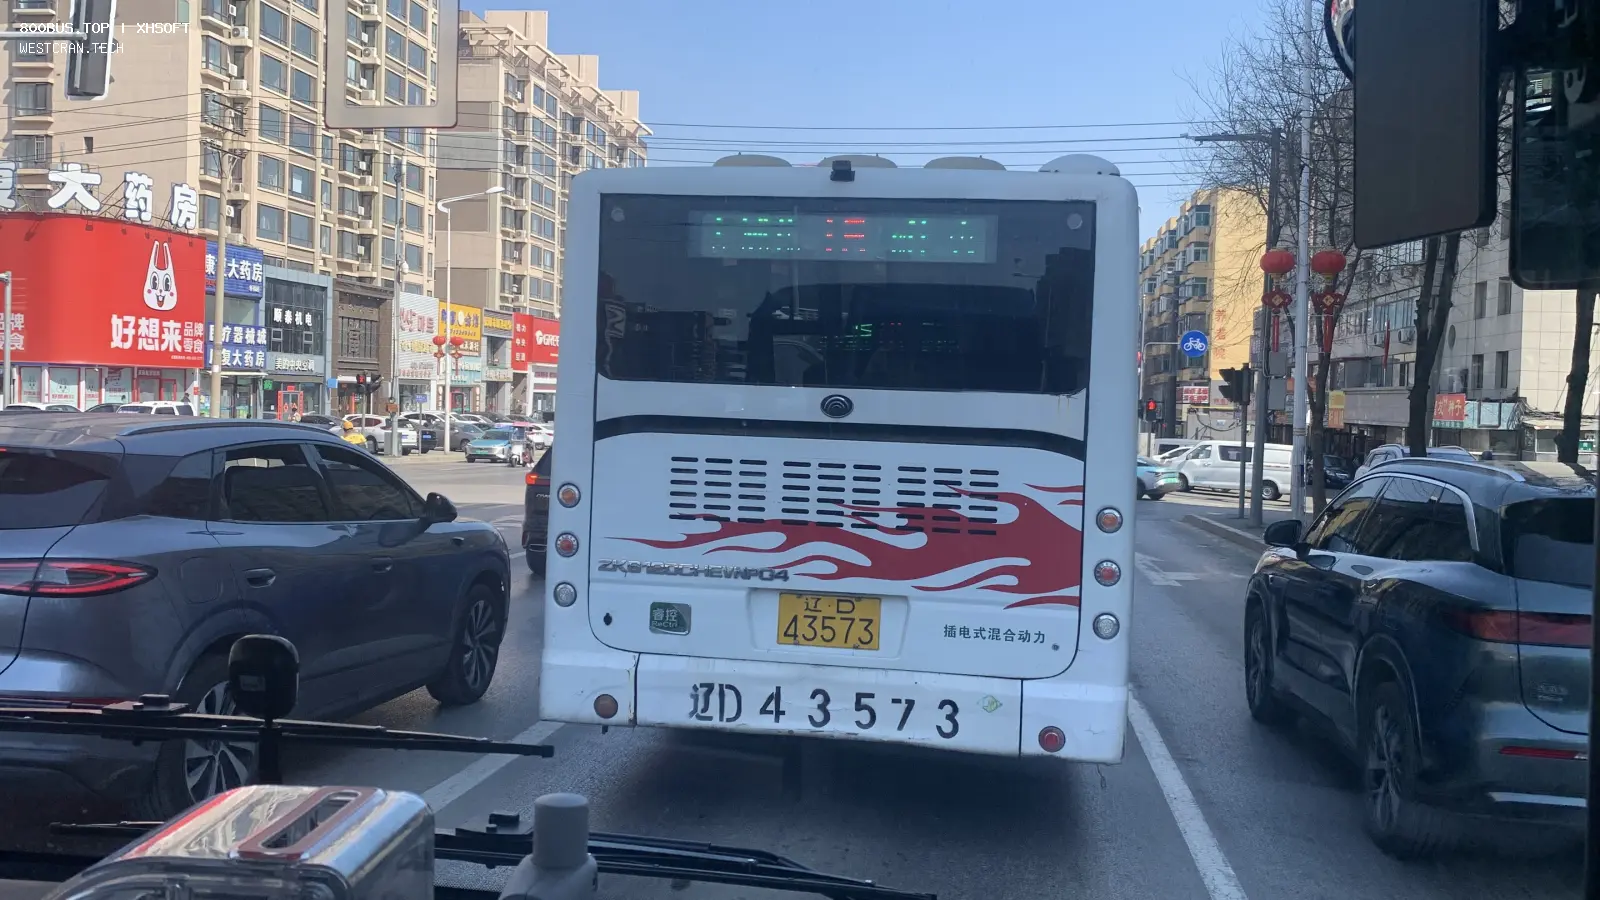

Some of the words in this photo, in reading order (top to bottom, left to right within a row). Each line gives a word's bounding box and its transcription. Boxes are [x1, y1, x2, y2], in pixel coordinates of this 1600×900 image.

[205, 253, 263, 282] 康大药房
[273, 306, 313, 327] 顺泰机电
[110, 314, 182, 352] 好想来
[183, 321, 203, 338] 品牌
[183, 338, 203, 353] 零食
[651, 620, 678, 629] ReCtrl
[652, 607, 677, 622] 睿控
[783, 614, 874, 645] 43573
[943, 624, 1046, 644] 插电式混合动力
